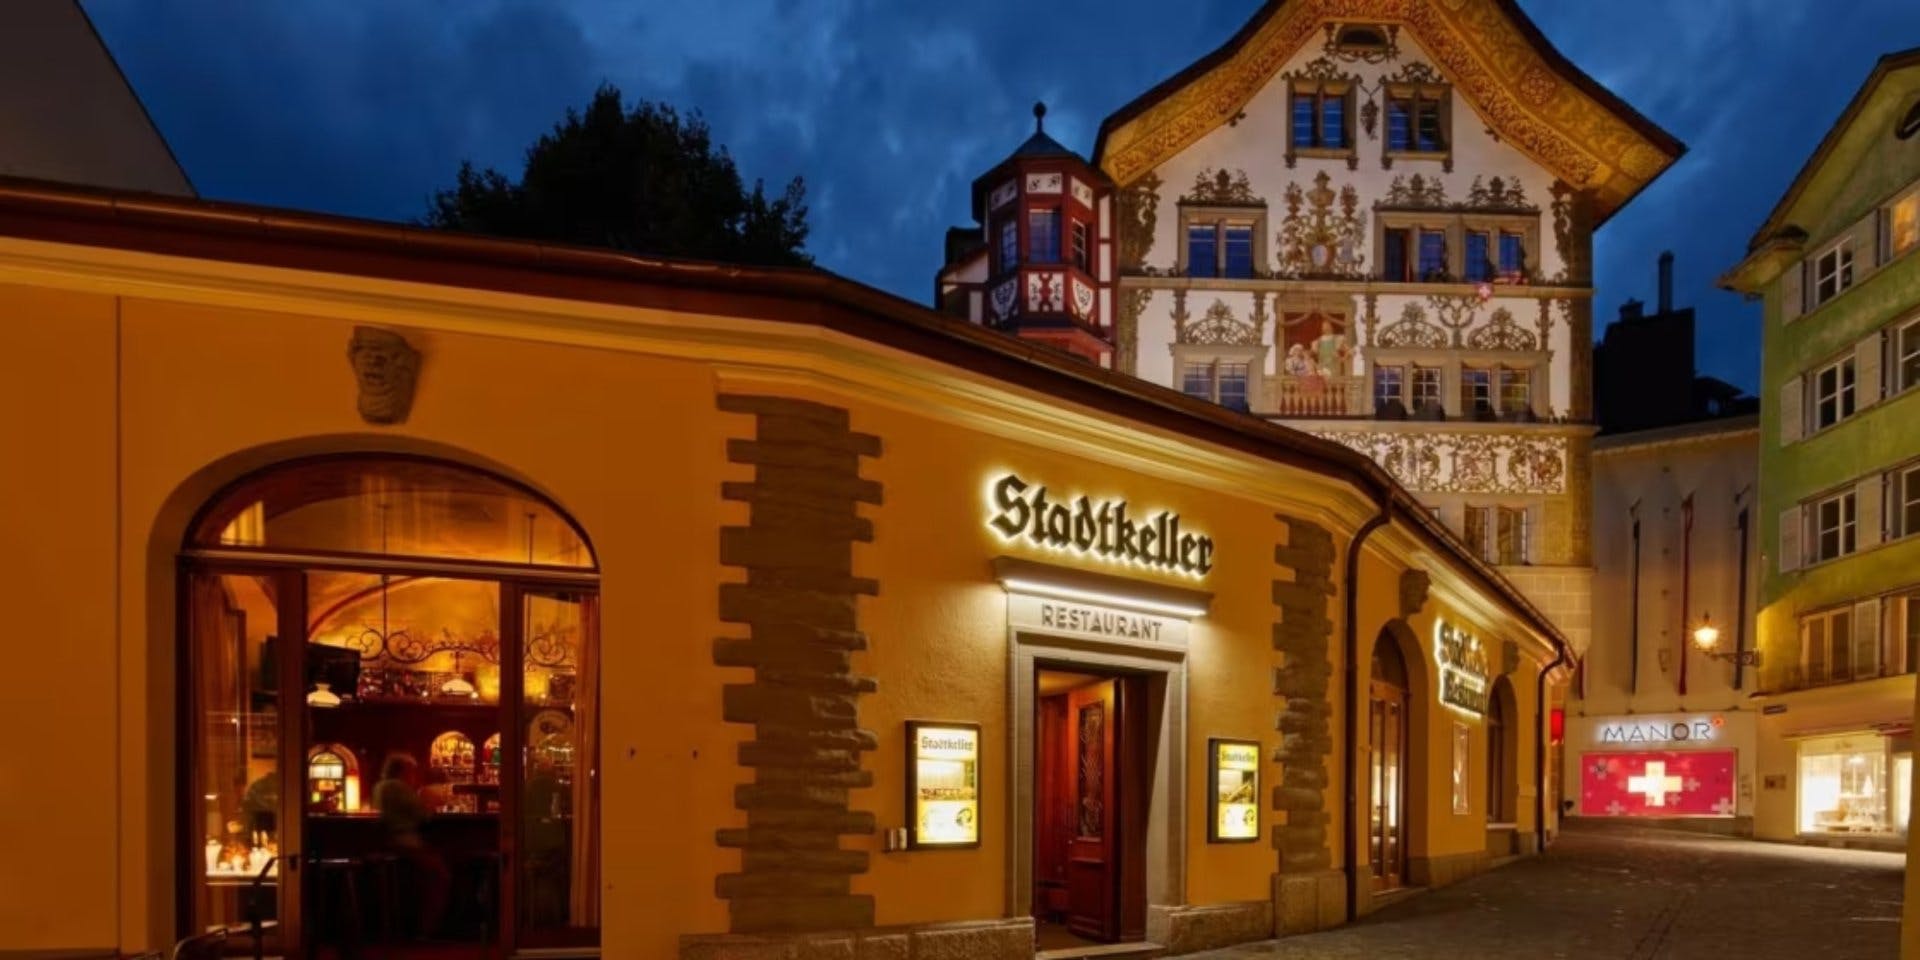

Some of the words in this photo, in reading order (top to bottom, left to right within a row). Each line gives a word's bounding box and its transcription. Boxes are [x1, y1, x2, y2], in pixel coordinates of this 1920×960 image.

[991, 474, 1214, 576] Stadtkeller
[1042, 603, 1162, 641] RESTAURANT
[1602, 722, 1712, 744] MANOR
